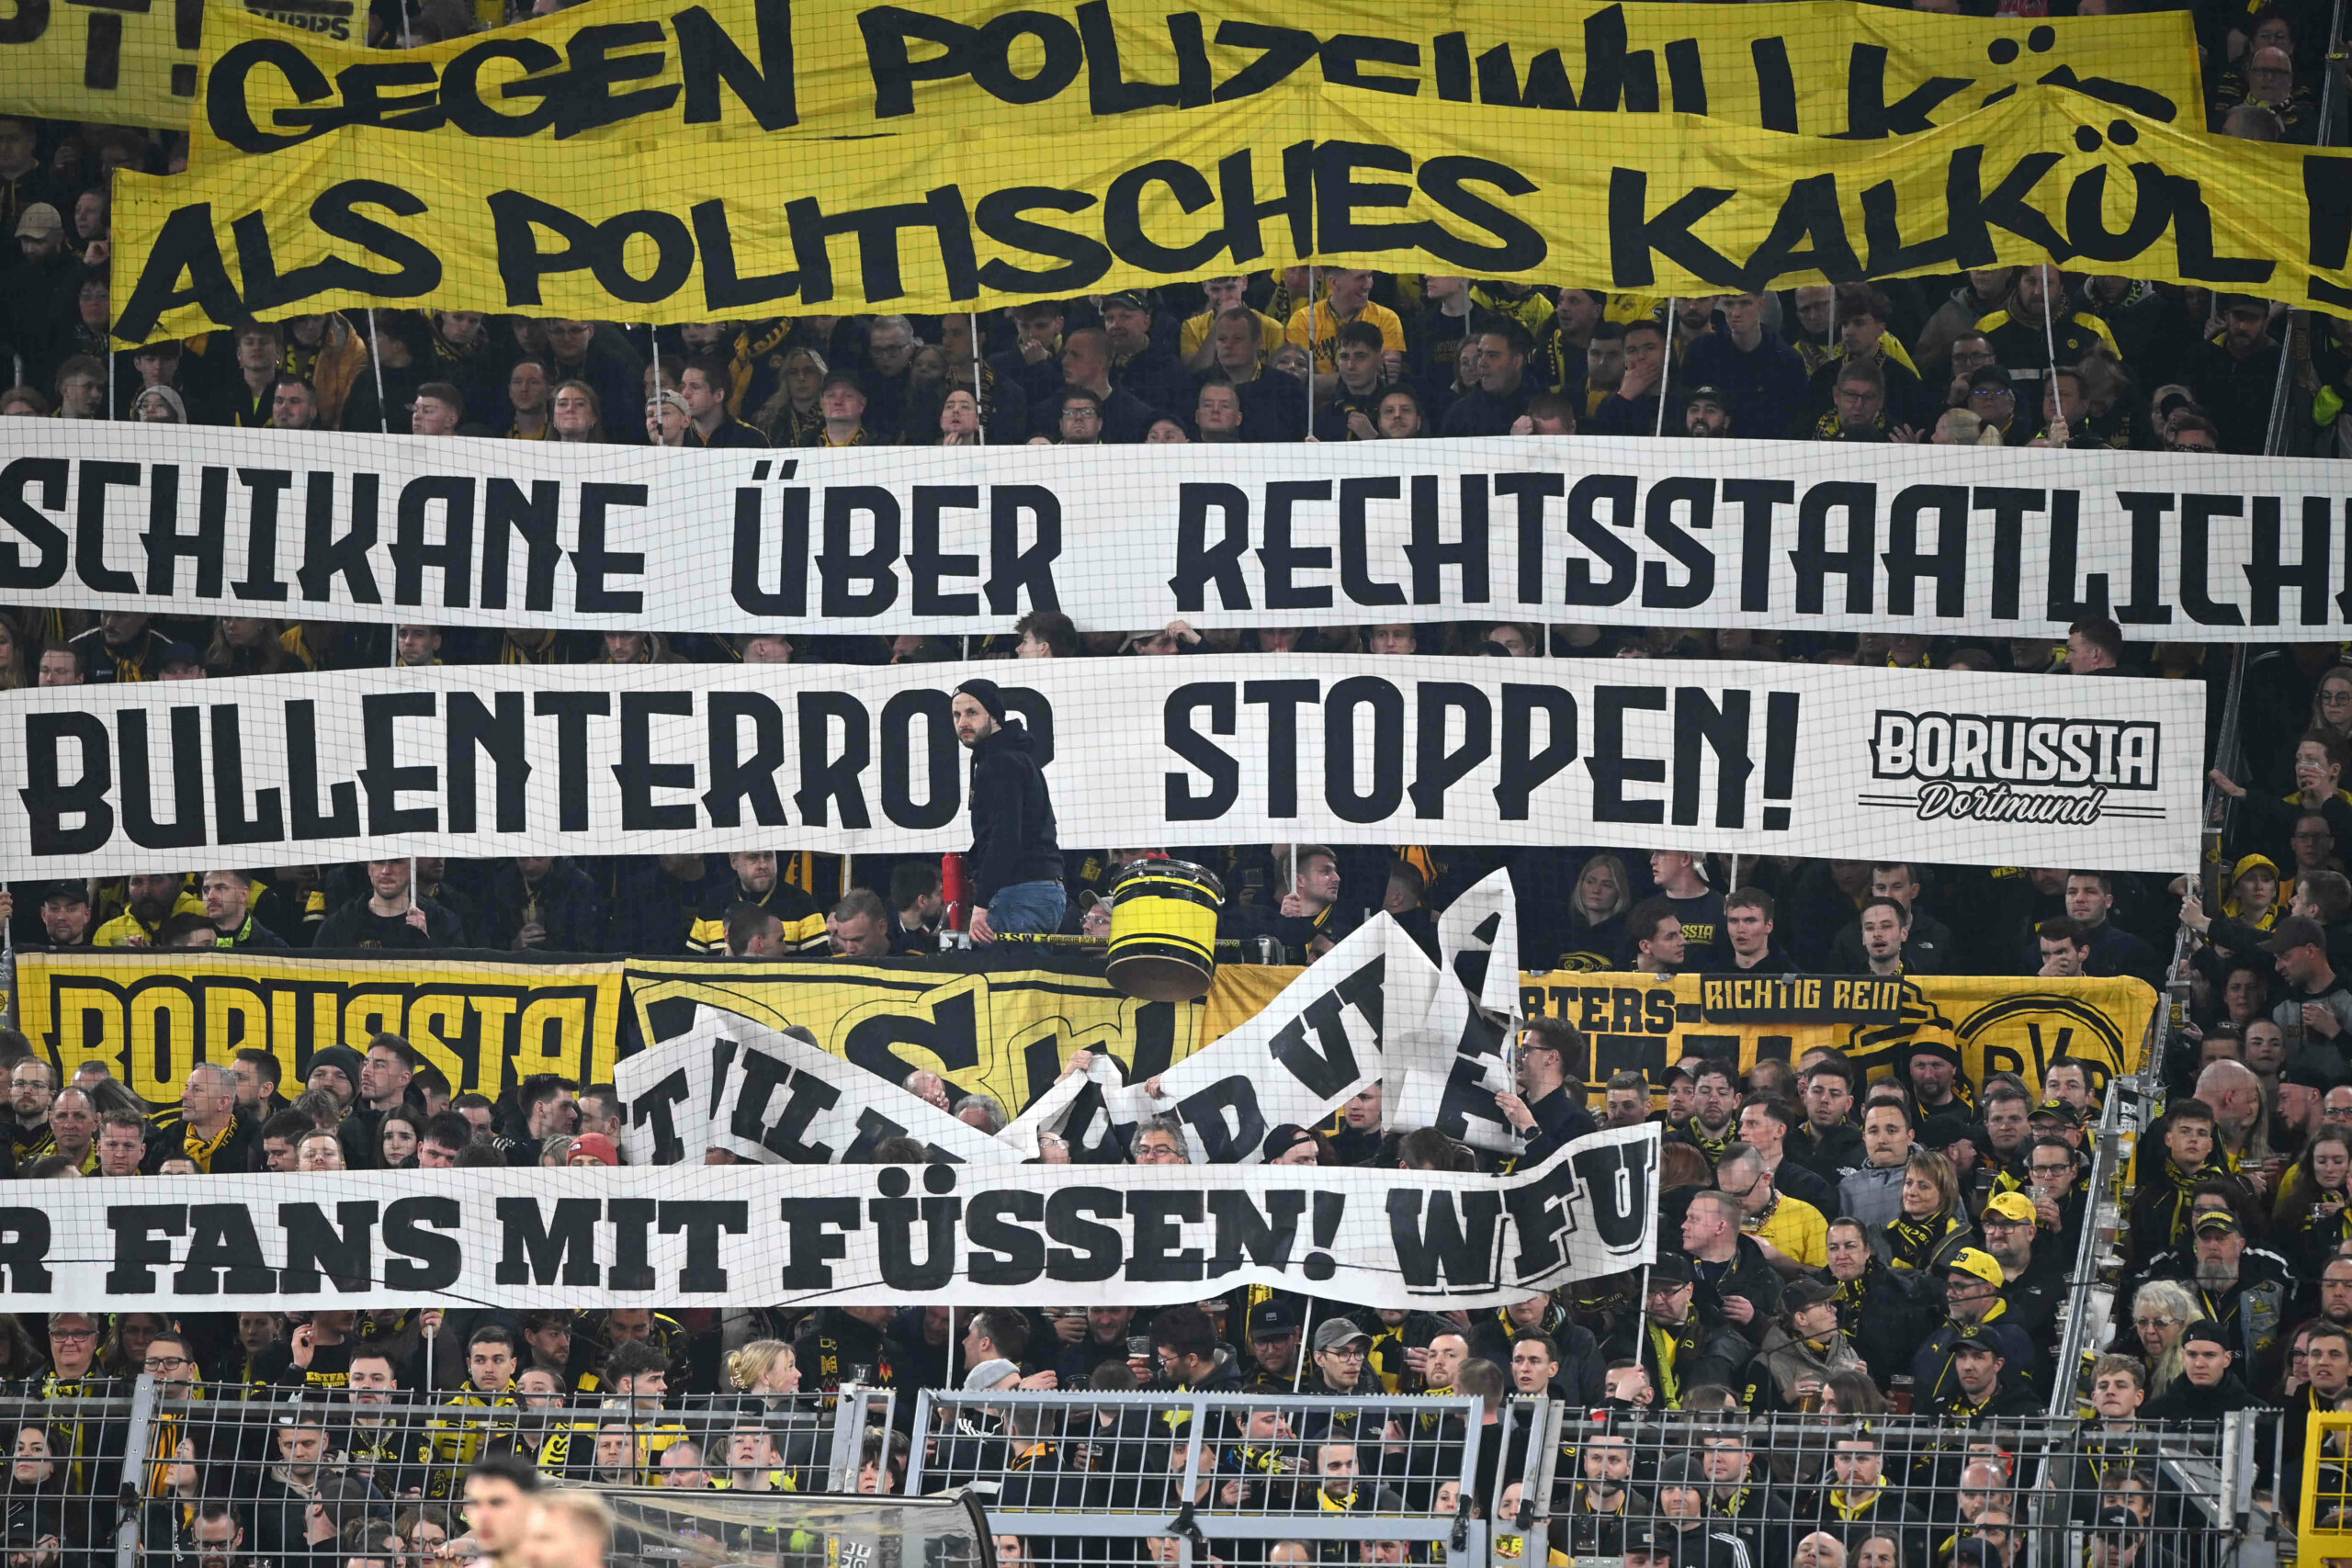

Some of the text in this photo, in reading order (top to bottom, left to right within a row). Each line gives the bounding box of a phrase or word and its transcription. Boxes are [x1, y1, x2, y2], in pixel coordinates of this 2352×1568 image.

[206, 0, 799, 153] GEGEN
[110, 179, 443, 344] ALS
[487, 140, 1548, 310] POLITISCHES
[0, 457, 2352, 626] SCHIKANE ÜBER RECHTSSTAATLICH
[1164, 675, 1800, 831] STOPPEN!
[1869, 709, 2161, 791] BORUSSIA
[1917, 780, 2108, 825] Dortmund
[1704, 979, 1901, 1010] RICHTIG REIN
[106, 1196, 461, 1295] FANS
[494, 1197, 748, 1293] MIT
[781, 1167, 1343, 1292] FÜSSEN!
[1385, 1135, 1657, 1296] WFU
